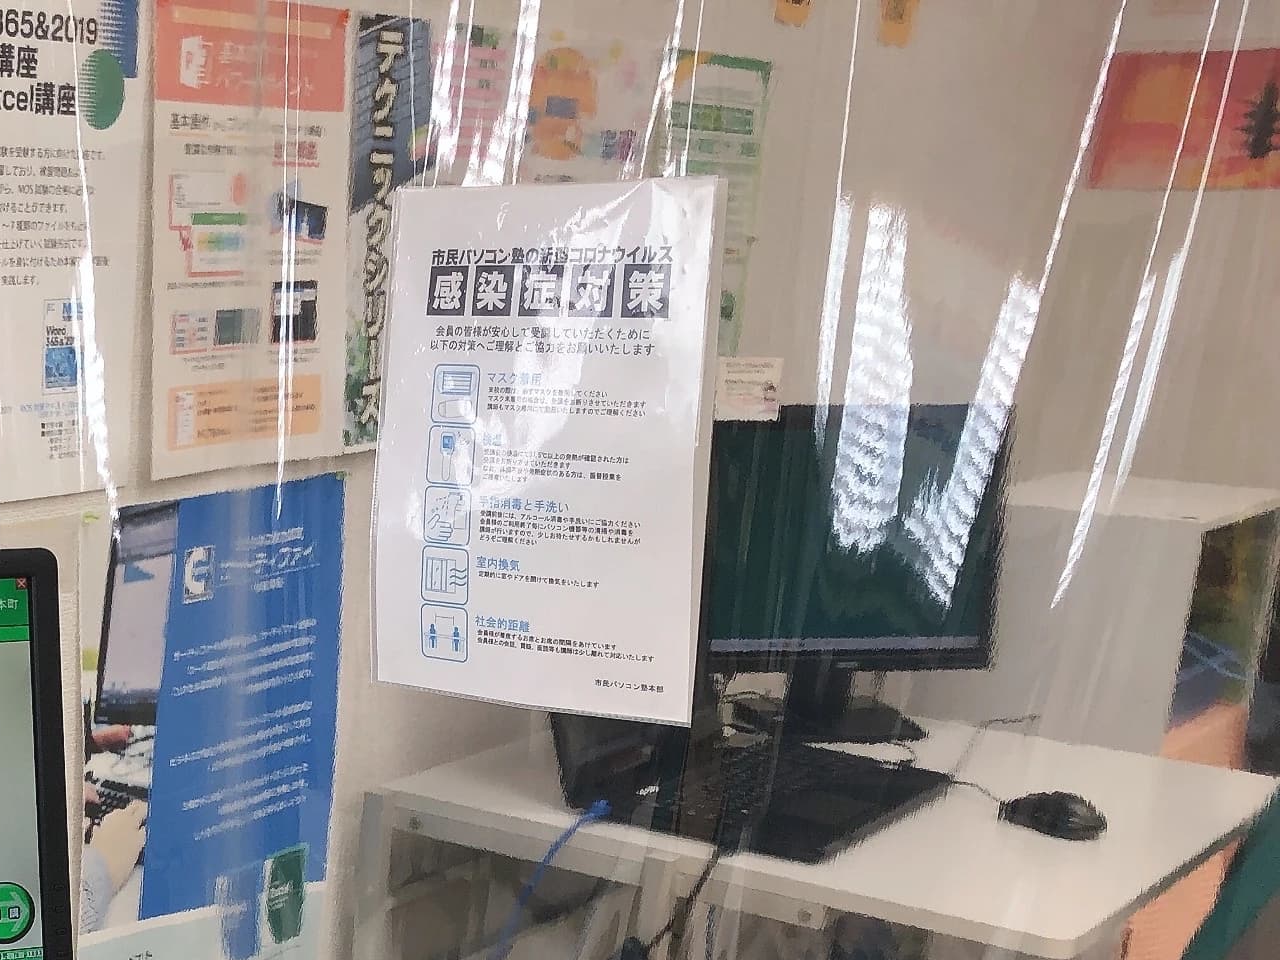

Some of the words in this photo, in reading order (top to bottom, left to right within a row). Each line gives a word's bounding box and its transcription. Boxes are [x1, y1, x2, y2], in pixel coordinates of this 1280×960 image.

[432, 246, 673, 265] 市民パソコン塾の新型コロナウイルス
[430, 269, 667, 315] 感染症対策
[476, 556, 521, 572] 室内換気
[475, 615, 530, 633] 社会的距離
